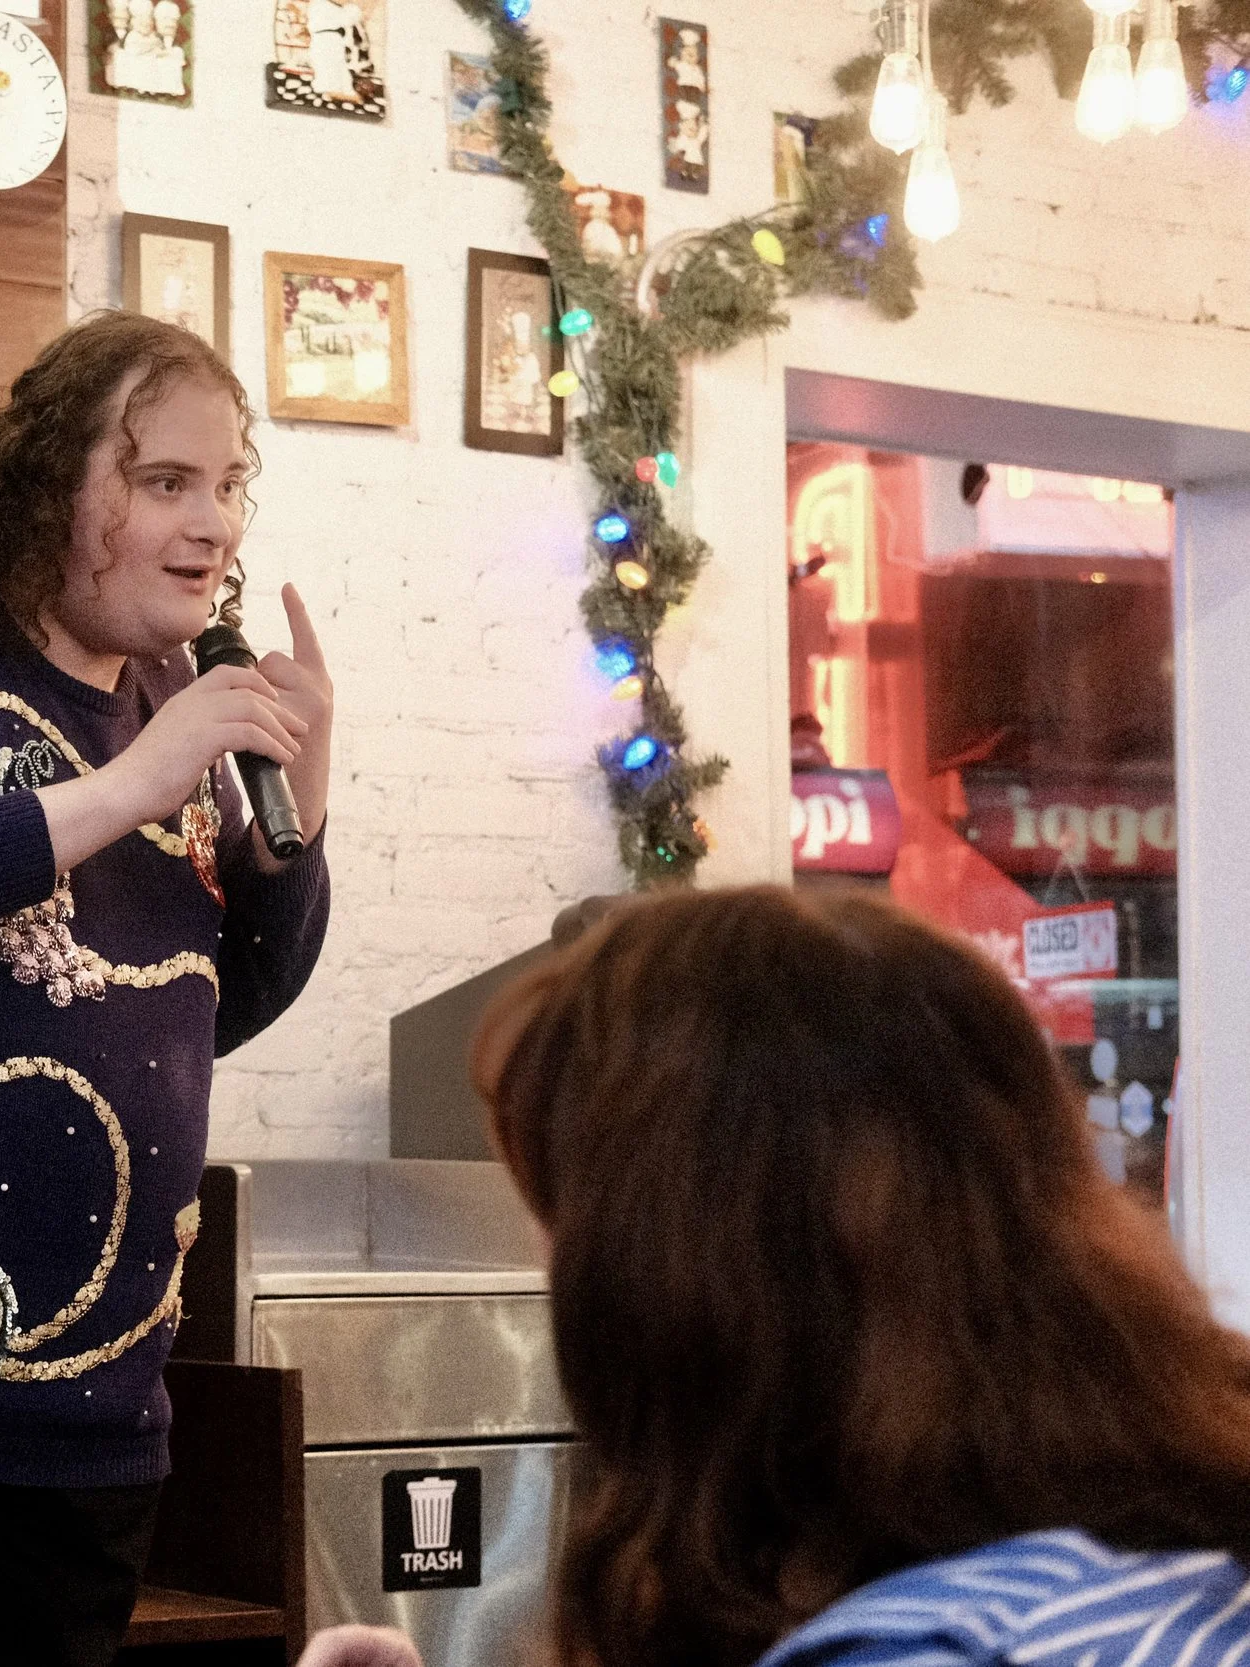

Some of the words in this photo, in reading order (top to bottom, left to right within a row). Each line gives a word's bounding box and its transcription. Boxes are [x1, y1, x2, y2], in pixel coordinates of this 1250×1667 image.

[791, 777, 872, 860] pi
[1028, 920, 1079, 954] CLOSED
[400, 1549, 463, 1573] TRASH
